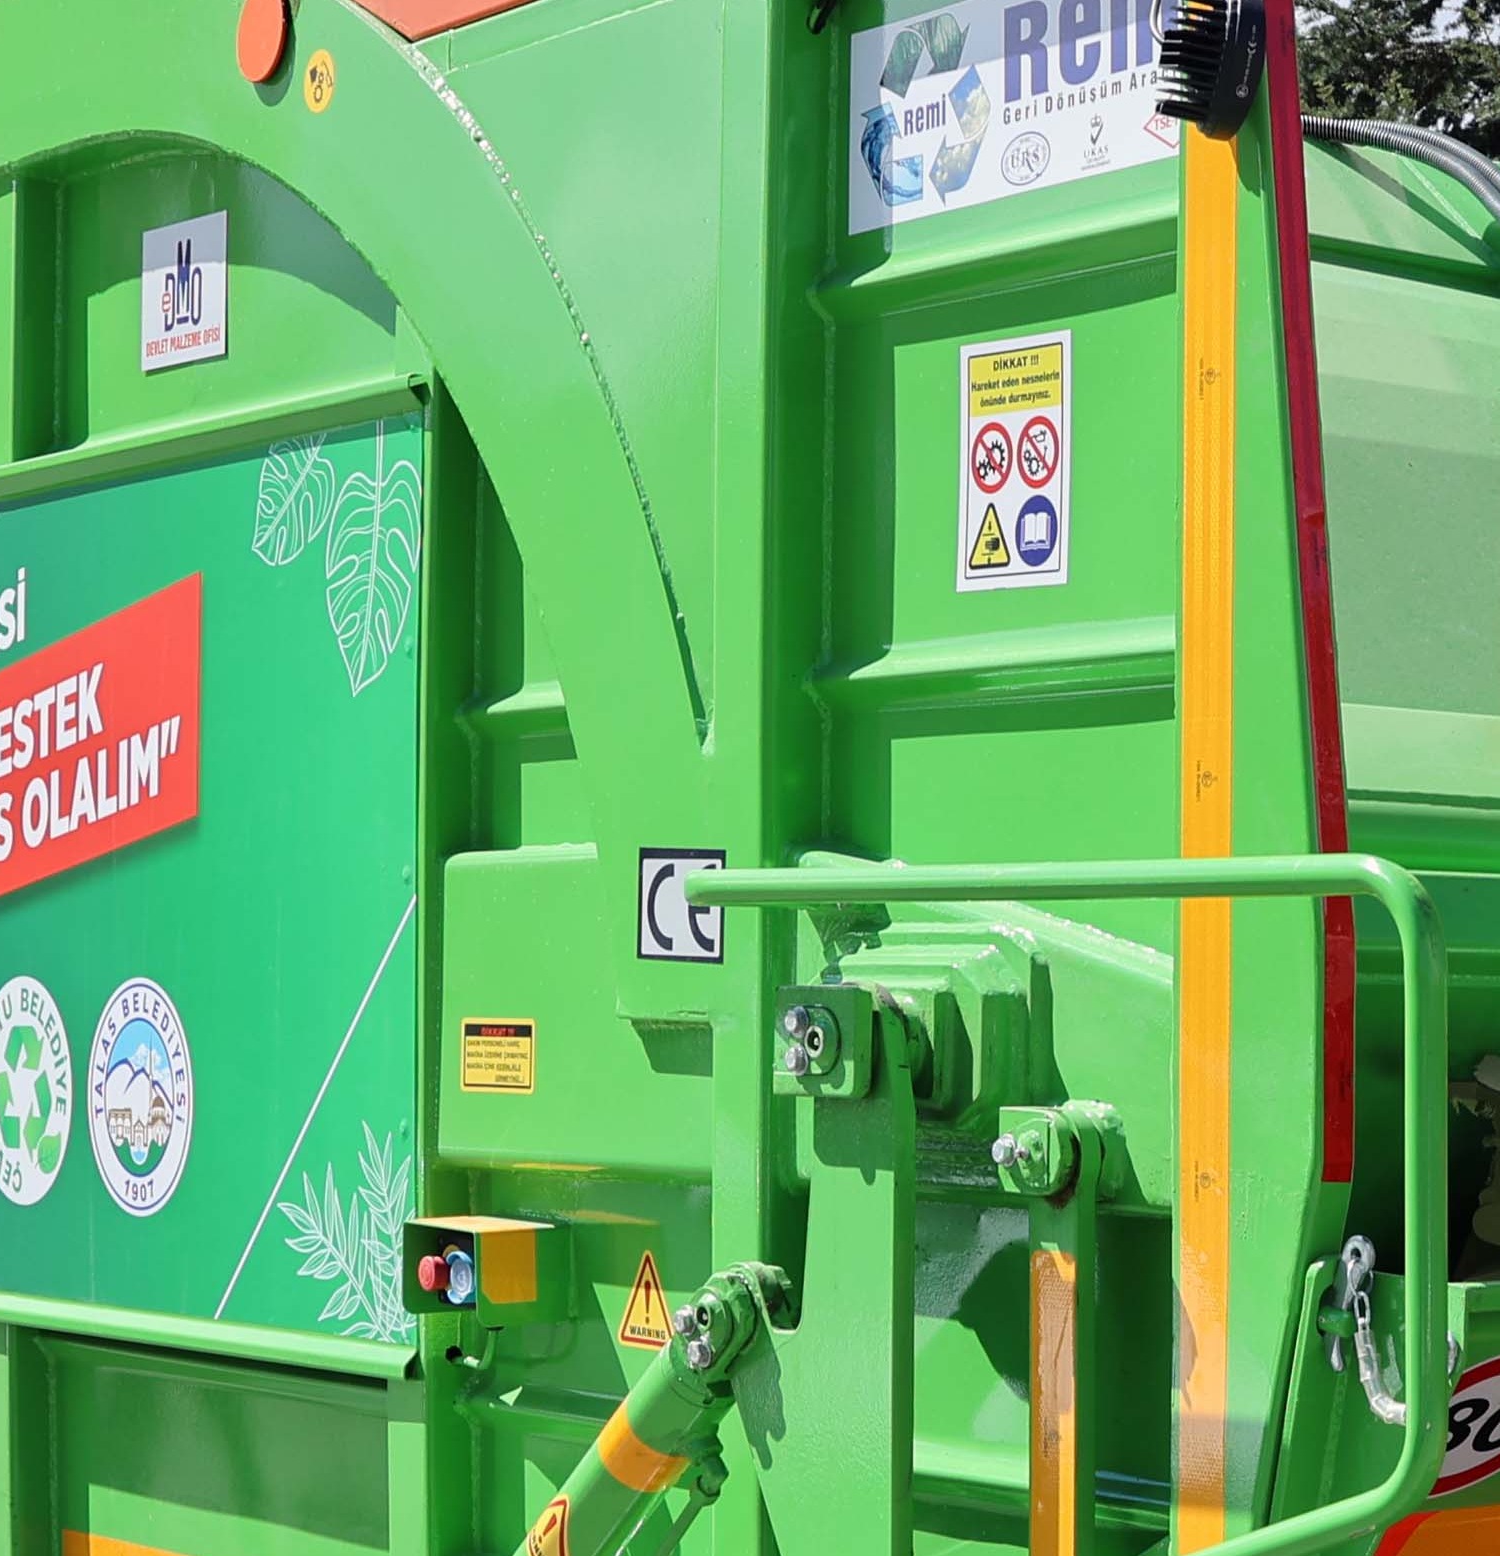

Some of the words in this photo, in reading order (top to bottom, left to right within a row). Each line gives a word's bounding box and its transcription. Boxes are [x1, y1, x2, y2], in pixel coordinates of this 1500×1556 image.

[904, 93, 947, 137] Remi
[1003, 103, 1038, 126] Geri
[1045, 80, 1122, 114] Dönüşüm
[146, 339, 168, 357] DEVLET
[170, 331, 202, 352] MALZEME
[203, 324, 221, 343] OFİSİ
[993, 356, 1028, 371] DİKKAT
[971, 379, 1000, 392] Hareket
[1001, 376, 1019, 389] eden
[1021, 370, 1060, 385] nesnelerin
[980, 394, 1006, 408] önünde
[22, 715, 181, 848] OLALIM"
[20, 988, 68, 1115] BELEDİYE
[94, 1019, 116, 1118] TALAS
[122, 992, 187, 1124] BELEDİYESİ
[124, 1179, 155, 1202] 1907
[629, 1325, 666, 1339] WARNING
